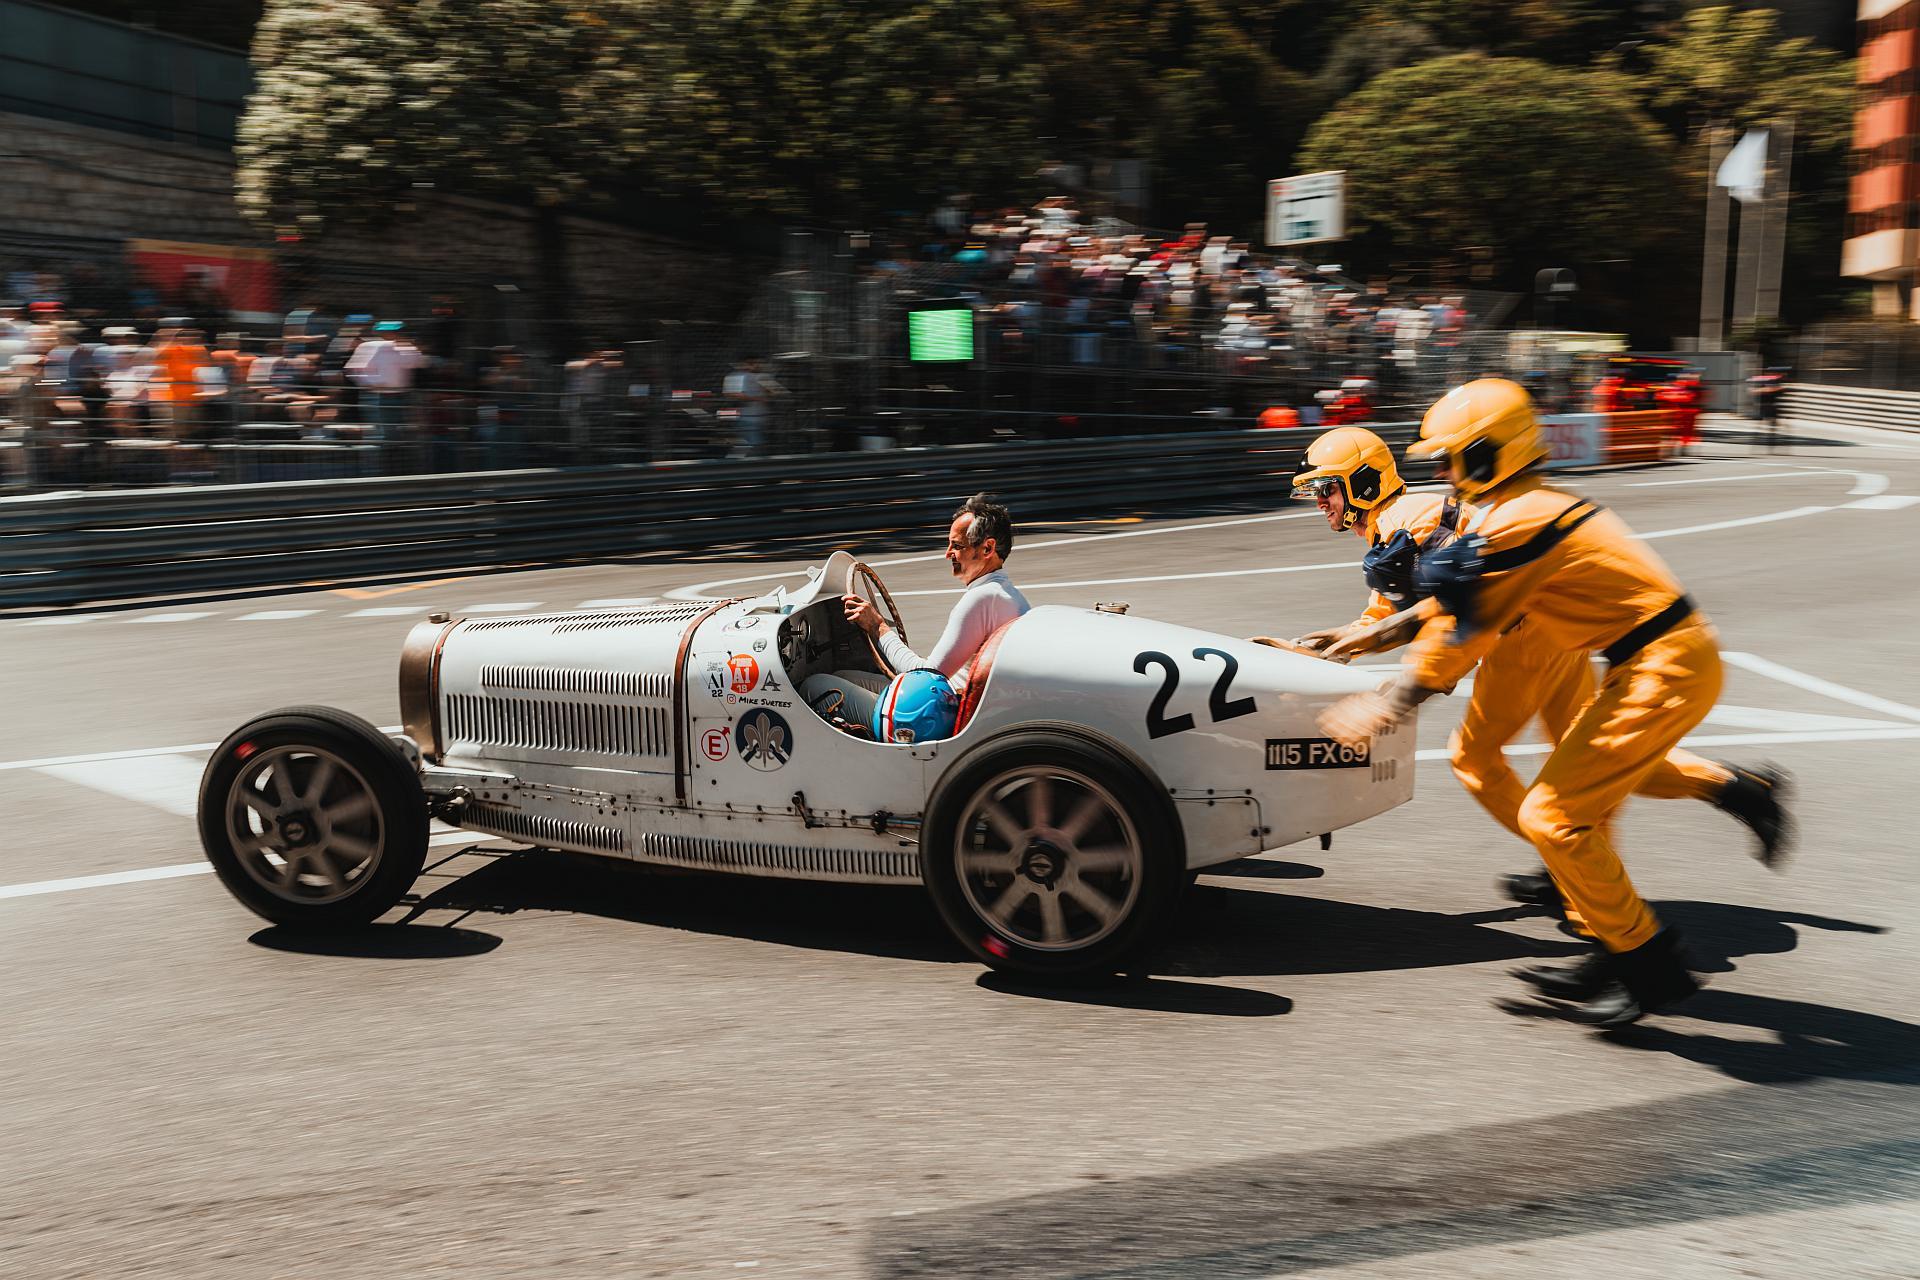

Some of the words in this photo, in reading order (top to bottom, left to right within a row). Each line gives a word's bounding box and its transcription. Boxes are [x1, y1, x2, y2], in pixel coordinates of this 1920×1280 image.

[711, 689, 724, 698] 22
[738, 696, 759, 705] MIKE
[761, 697, 792, 709] SURTEES
[1133, 647, 1258, 740] 22
[708, 735, 723, 756] E
[1268, 744, 1302, 765] 1115
